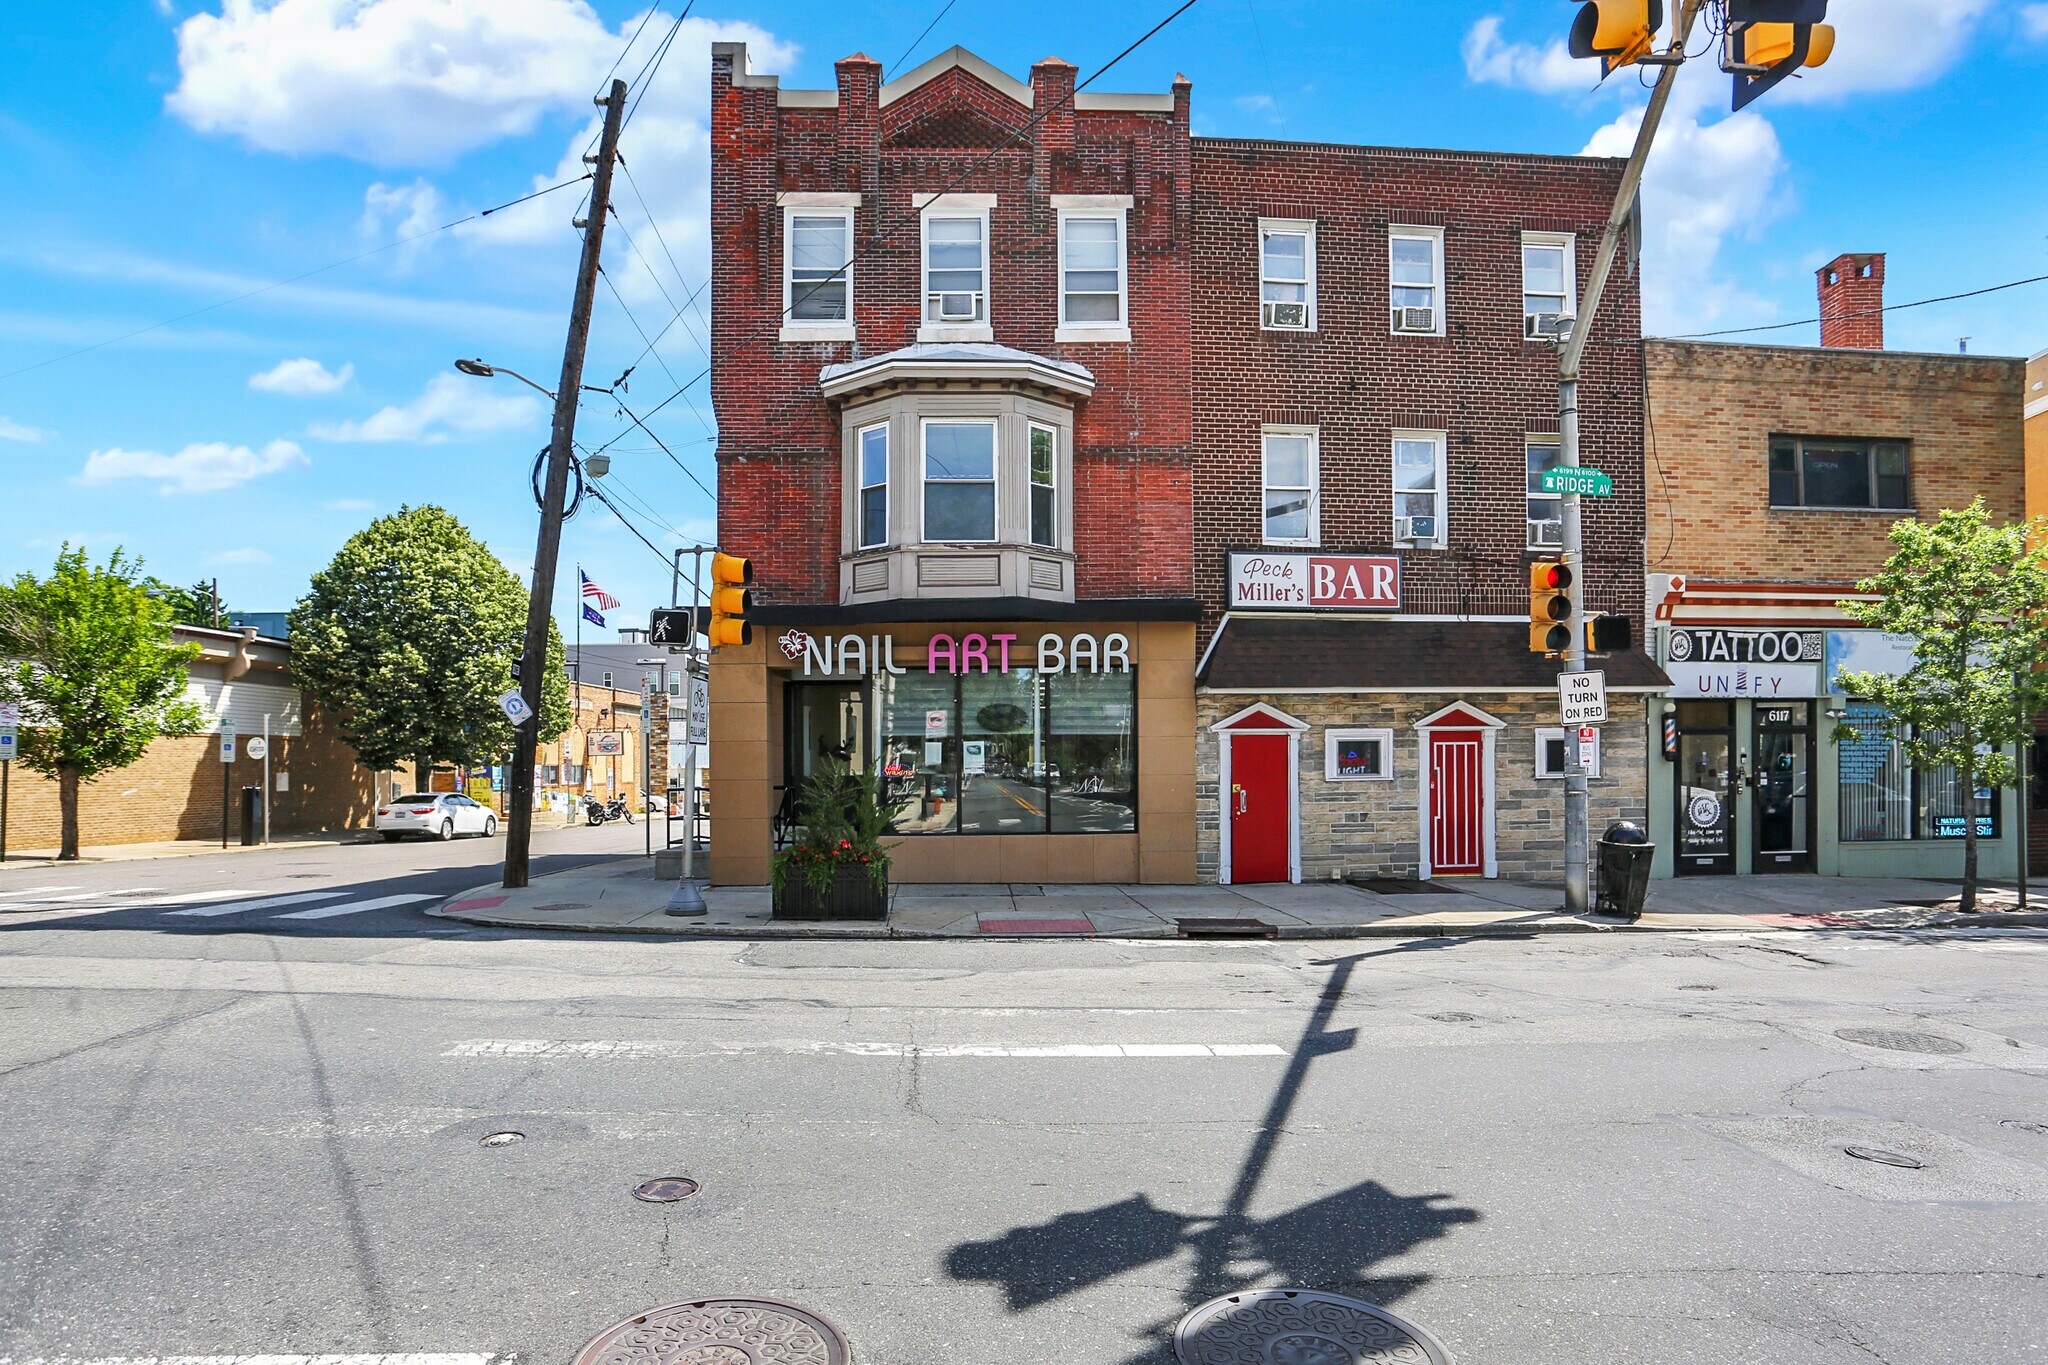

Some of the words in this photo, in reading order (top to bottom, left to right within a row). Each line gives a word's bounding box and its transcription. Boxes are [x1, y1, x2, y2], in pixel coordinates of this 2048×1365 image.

[1559, 467, 1573, 475] 6199
[1574, 468, 1580, 476] N
[1581, 469, 1596, 477] 6100
[1556, 476, 1594, 493] RIDGE
[1598, 485, 1610, 494] AV
[1243, 558, 1293, 579] Peck
[1311, 564, 1397, 600] BAR
[1238, 582, 1304, 602] Miller's
[1695, 631, 1802, 661] TATTOO
[803, 634, 906, 676] NAIL
[928, 633, 1017, 675] ART
[1037, 633, 1130, 674] BAR
[1573, 678, 1590, 688] NO
[1568, 692, 1598, 703] TURN
[1565, 709, 1580, 719] ON
[1583, 706, 1602, 717] RED
[1769, 710, 1790, 721] 6117
[1940, 826, 1967, 836] Musc
